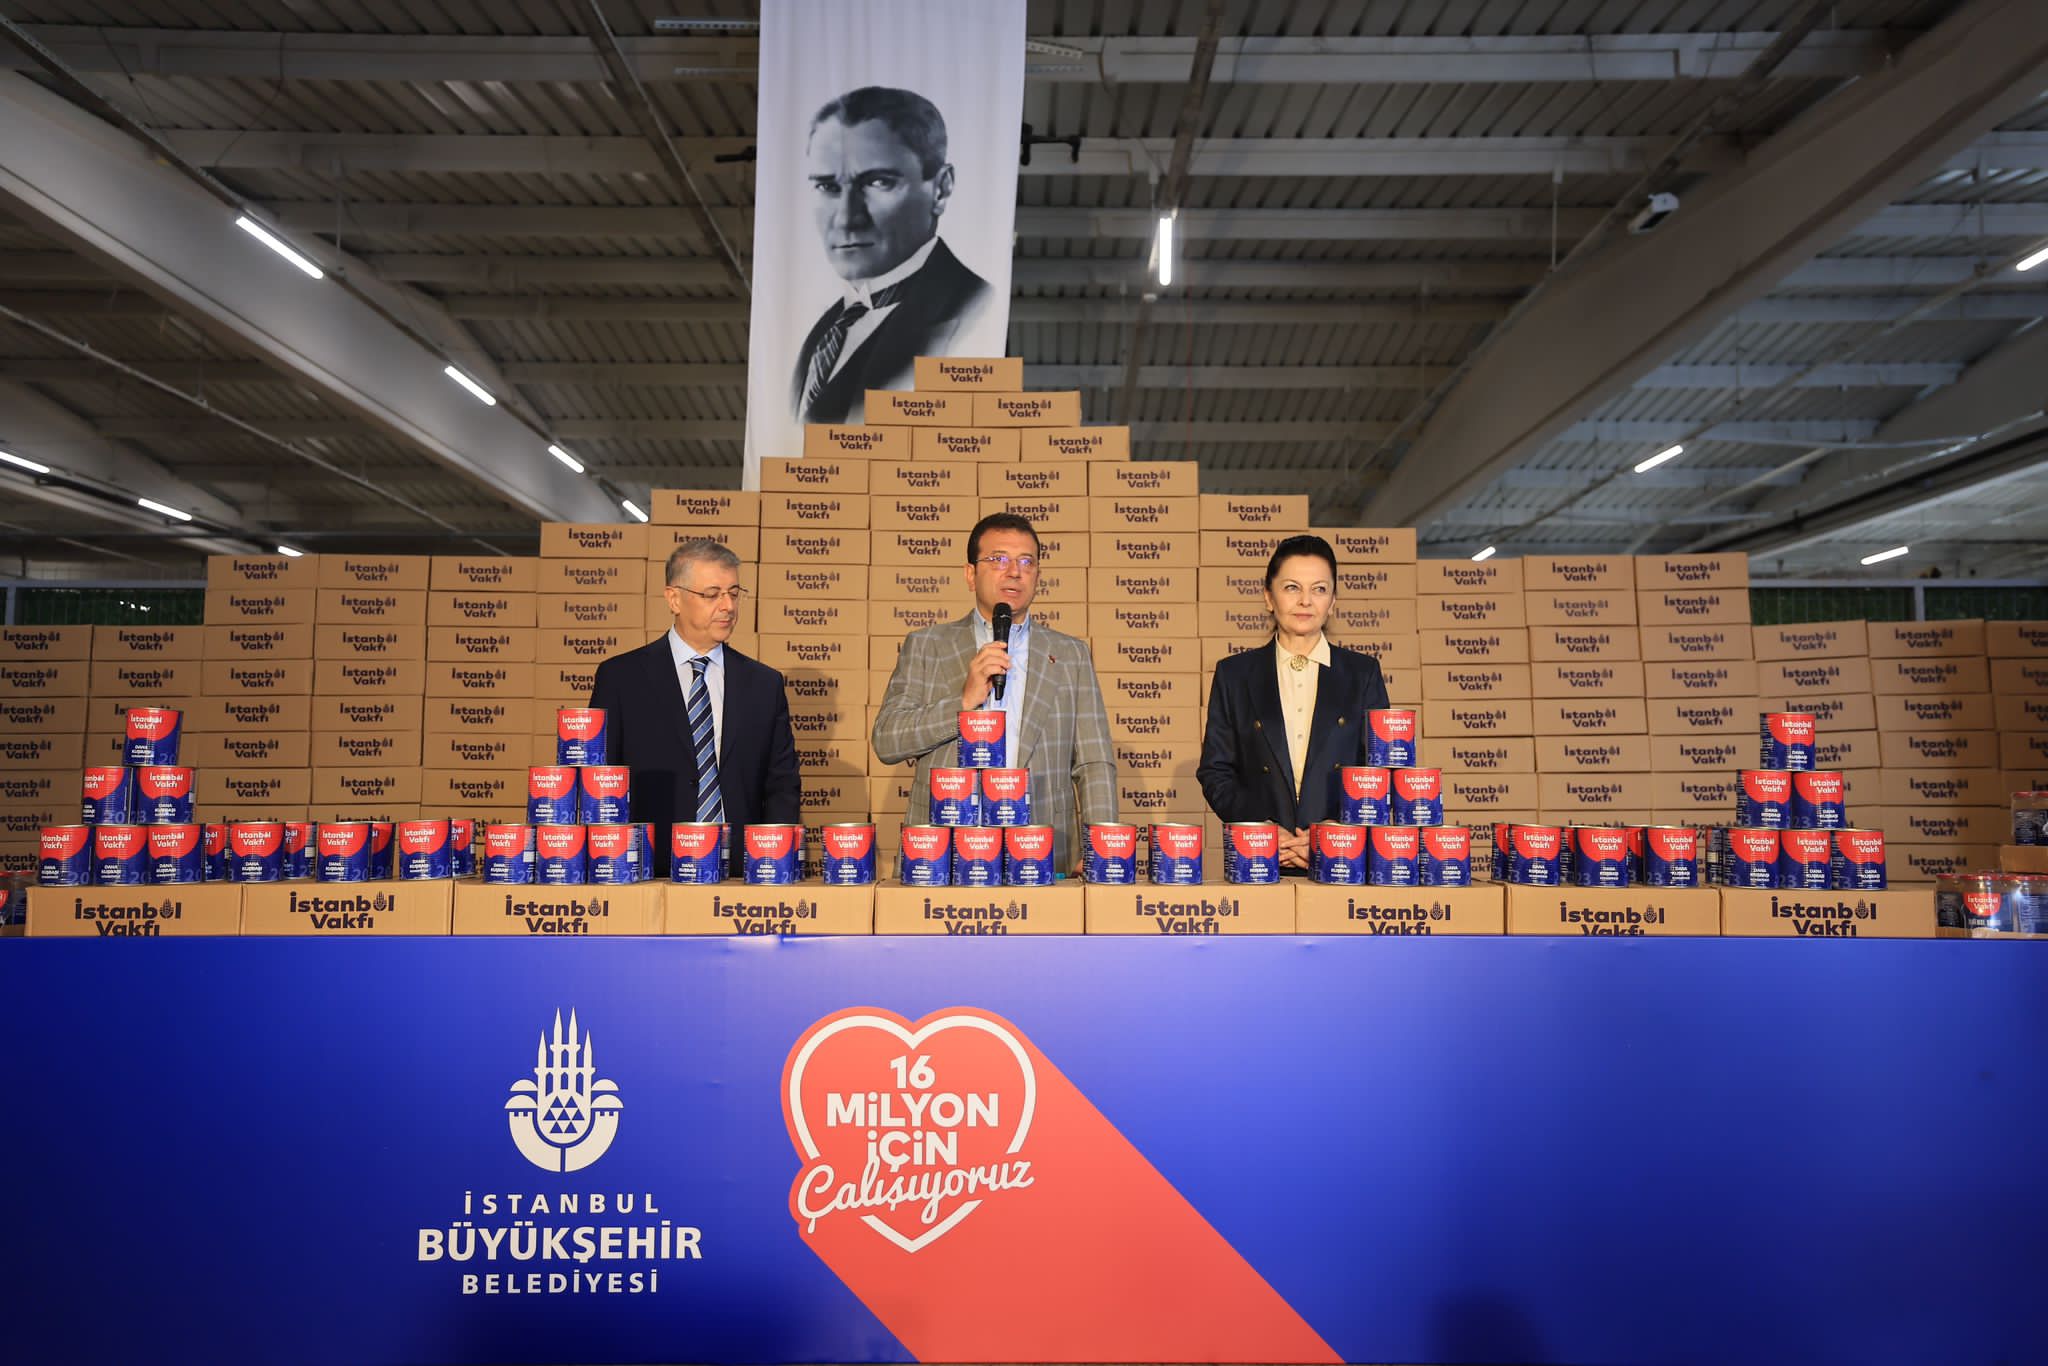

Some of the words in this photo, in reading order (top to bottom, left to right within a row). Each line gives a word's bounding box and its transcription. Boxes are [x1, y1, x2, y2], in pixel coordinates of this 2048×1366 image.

[75, 898, 181, 920] İstanbul
[290, 891, 394, 913] İstanbul
[506, 895, 608, 917] İstanbul
[714, 896, 816, 918] İstanbul
[925, 899, 1026, 920] İstanbul
[1136, 896, 1239, 916] İstanbul
[1348, 899, 1450, 920] İstanbul
[1560, 902, 1664, 924] İstanbul
[1771, 896, 1876, 920] İstanbul
[96, 920, 160, 936] Vakfı
[310, 913, 373, 929] Vakfı
[526, 918, 588, 933] Vakfı
[734, 919, 796, 935] Vakfı
[1156, 918, 1219, 933] Vakfı
[1792, 920, 1856, 936] Vakfı
[891, 1056, 936, 1090] 16
[464, 1190, 659, 1215] İSTANBUL
[797, 1156, 1035, 1234] Çalışıyoruz
[419, 1220, 702, 1263] BÜYÜKŞEHİR
[462, 1269, 658, 1295] BELEDİYESİ
